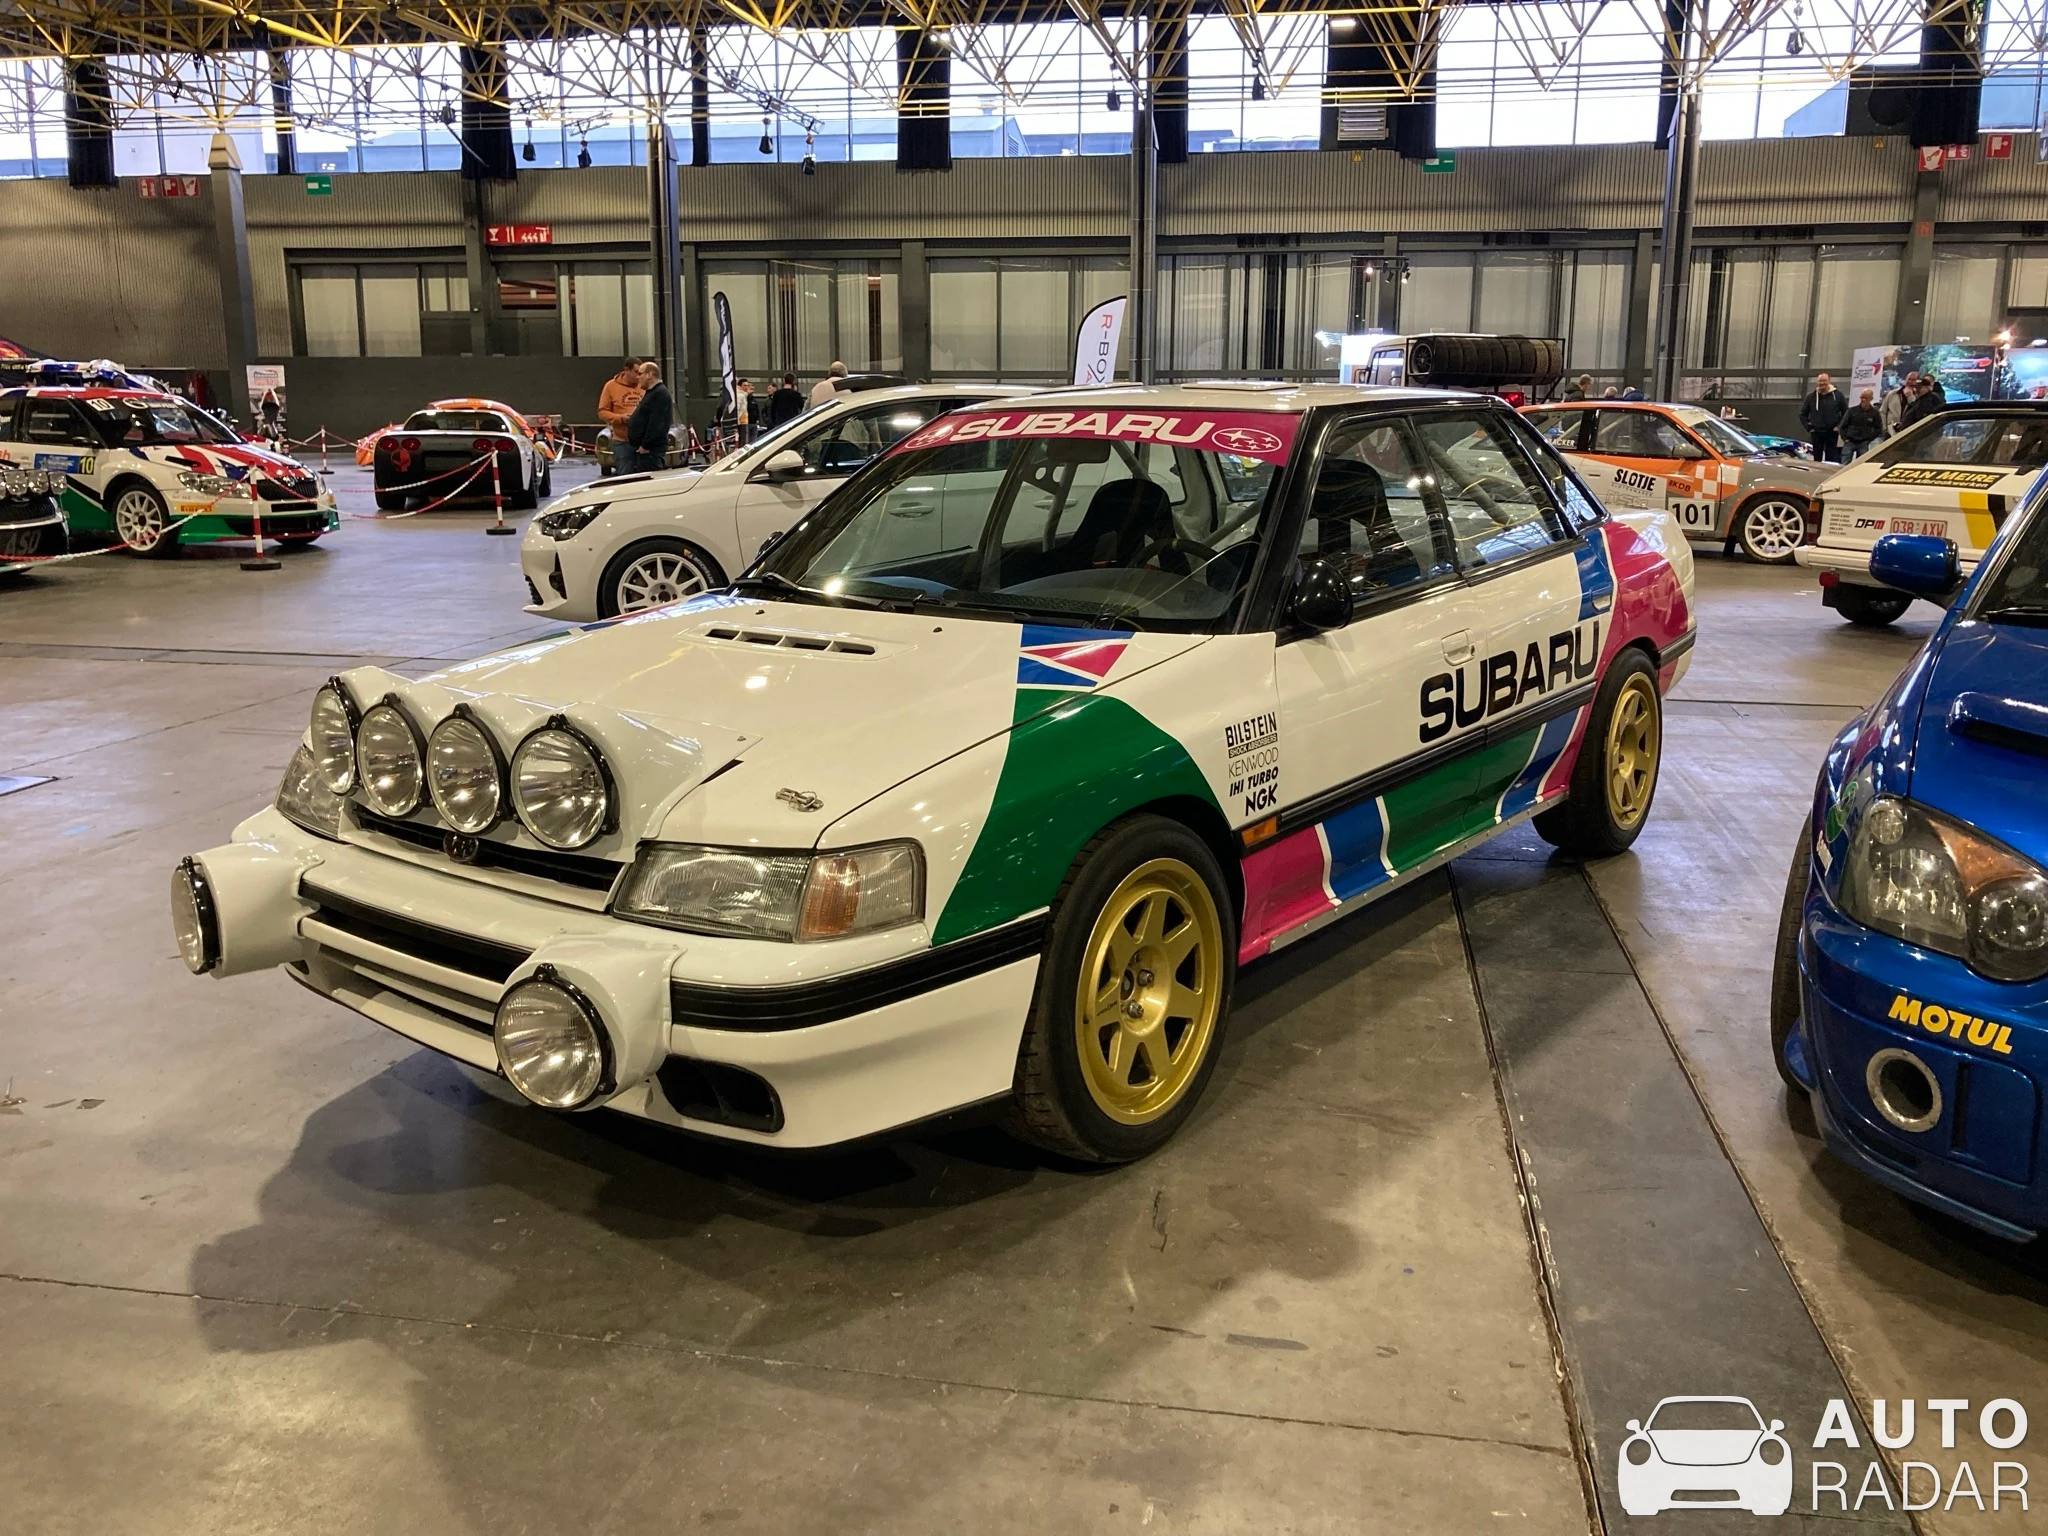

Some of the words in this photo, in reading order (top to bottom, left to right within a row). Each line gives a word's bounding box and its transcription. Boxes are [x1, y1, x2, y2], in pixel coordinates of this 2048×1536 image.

[91, 399, 110, 410] 10
[953, 412, 1215, 443] SUBARU
[80, 456, 94, 474] 10
[1887, 468, 1937, 479] STAN
[1936, 471, 2000, 483] MEIRE
[1614, 468, 1656, 491] SLOTJE
[1672, 503, 1710, 526] 101
[1855, 518, 1886, 530] DPM
[1419, 620, 1600, 744] SUBARU
[1225, 711, 1278, 748] BILSTEIN
[1229, 743, 1248, 758] SHOCK
[1248, 733, 1277, 750] ABSORBERS
[1228, 746, 1279, 779] KENWOOD
[1229, 781, 1244, 797] IHI
[1247, 766, 1279, 790] TURBO
[1245, 783, 1278, 817] NGK
[1888, 995, 2013, 1055] MOTUL
